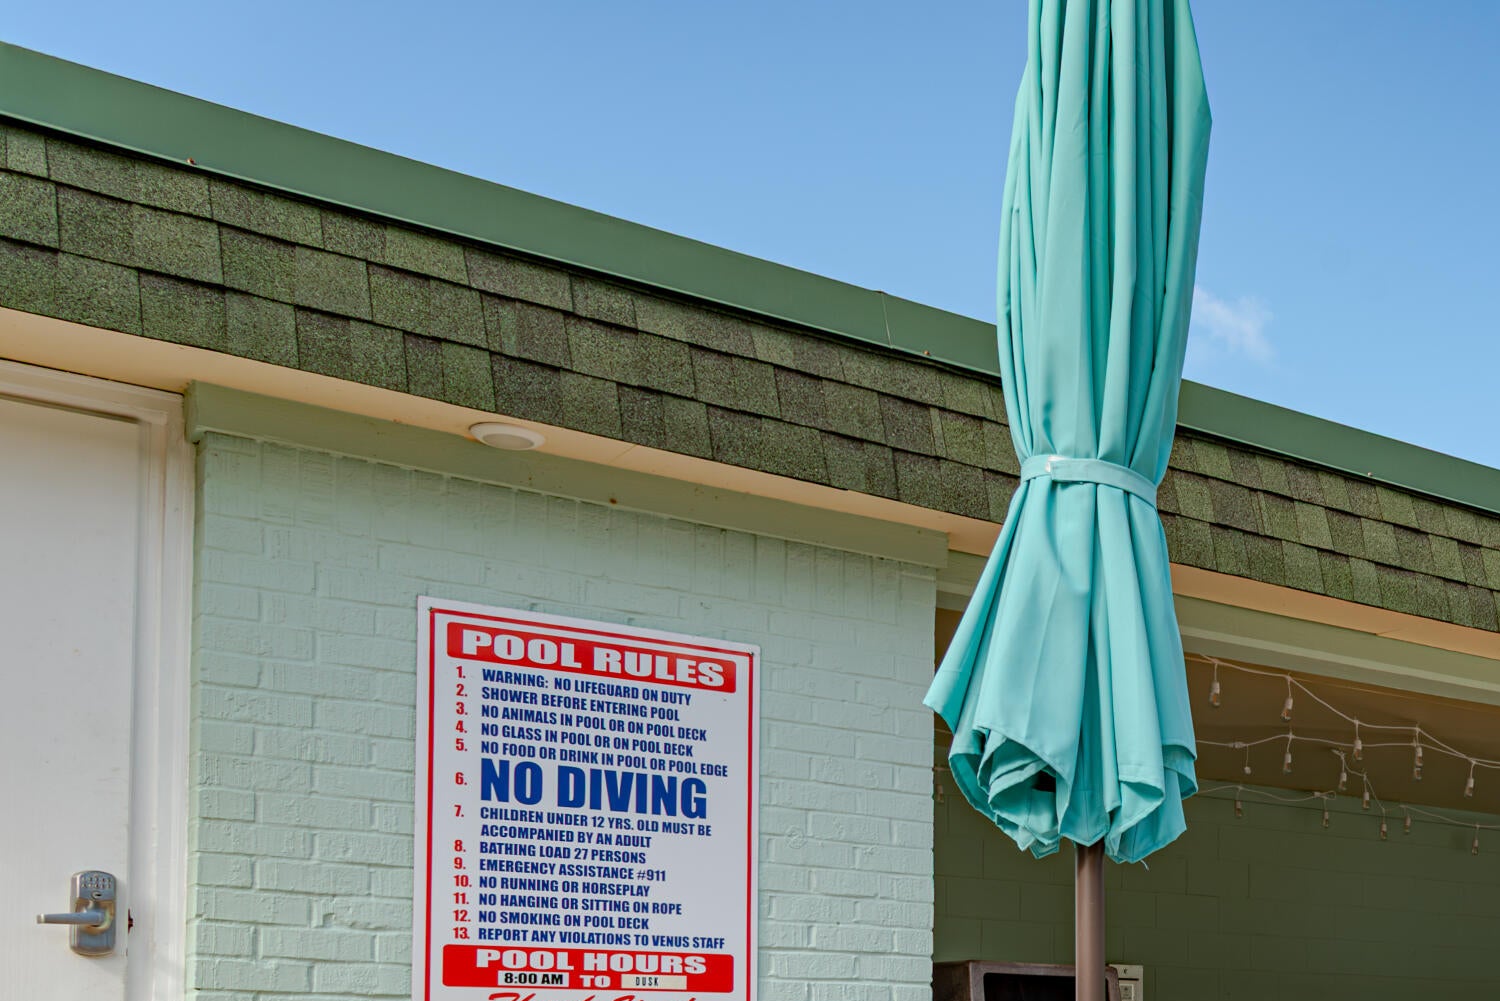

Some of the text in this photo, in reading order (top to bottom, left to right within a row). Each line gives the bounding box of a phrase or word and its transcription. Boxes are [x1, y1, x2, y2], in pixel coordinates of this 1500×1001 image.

[463, 629, 724, 686] POOL RULES
[456, 666, 691, 705] 1. WARNING: NO LIFEGUARD ON DUTY
[456, 684, 680, 721] 2. SHOWER BEFORE ENTERING POOL
[456, 702, 706, 741] 3. NO ANIMALS IN POOL OR ON POOL DECK
[456, 721, 693, 757] 4. NO GLASS IN POOL OR ON POOL DECK
[456, 738, 727, 777] 5. NO FOOD OR DRINK IN POOL OR POOL EDGE
[456, 758, 706, 819] 6. NO DIVING
[454, 805, 711, 836] 7. CHILDREN UNDER 12 YRS. OLD MUST BE
[481, 825, 651, 848] ACCOMPANIED BY AN ADULT
[454, 840, 646, 864] 8. BATHING LOAD 27 PERSONS
[454, 857, 666, 881] 9. EMERGENCY ASSISTANCE #911
[454, 875, 650, 897] 10. NO RUNNING OR HORSEPLAY
[454, 893, 682, 915] 11. NO HANGING OR SITTING ON ROPE
[453, 910, 649, 929] 12. NO SMOKING ON POOL DECK
[479, 928, 528, 941] REPORT
[531, 930, 556, 943] ANY
[559, 932, 631, 945] VIOLATIONS
[635, 935, 649, 946] TO
[652, 935, 689, 948] VENUS
[693, 937, 725, 949] STAFF
[476, 949, 706, 974] POOL HOURS
[504, 973, 659, 988] 8:00 AM TO DUSK
